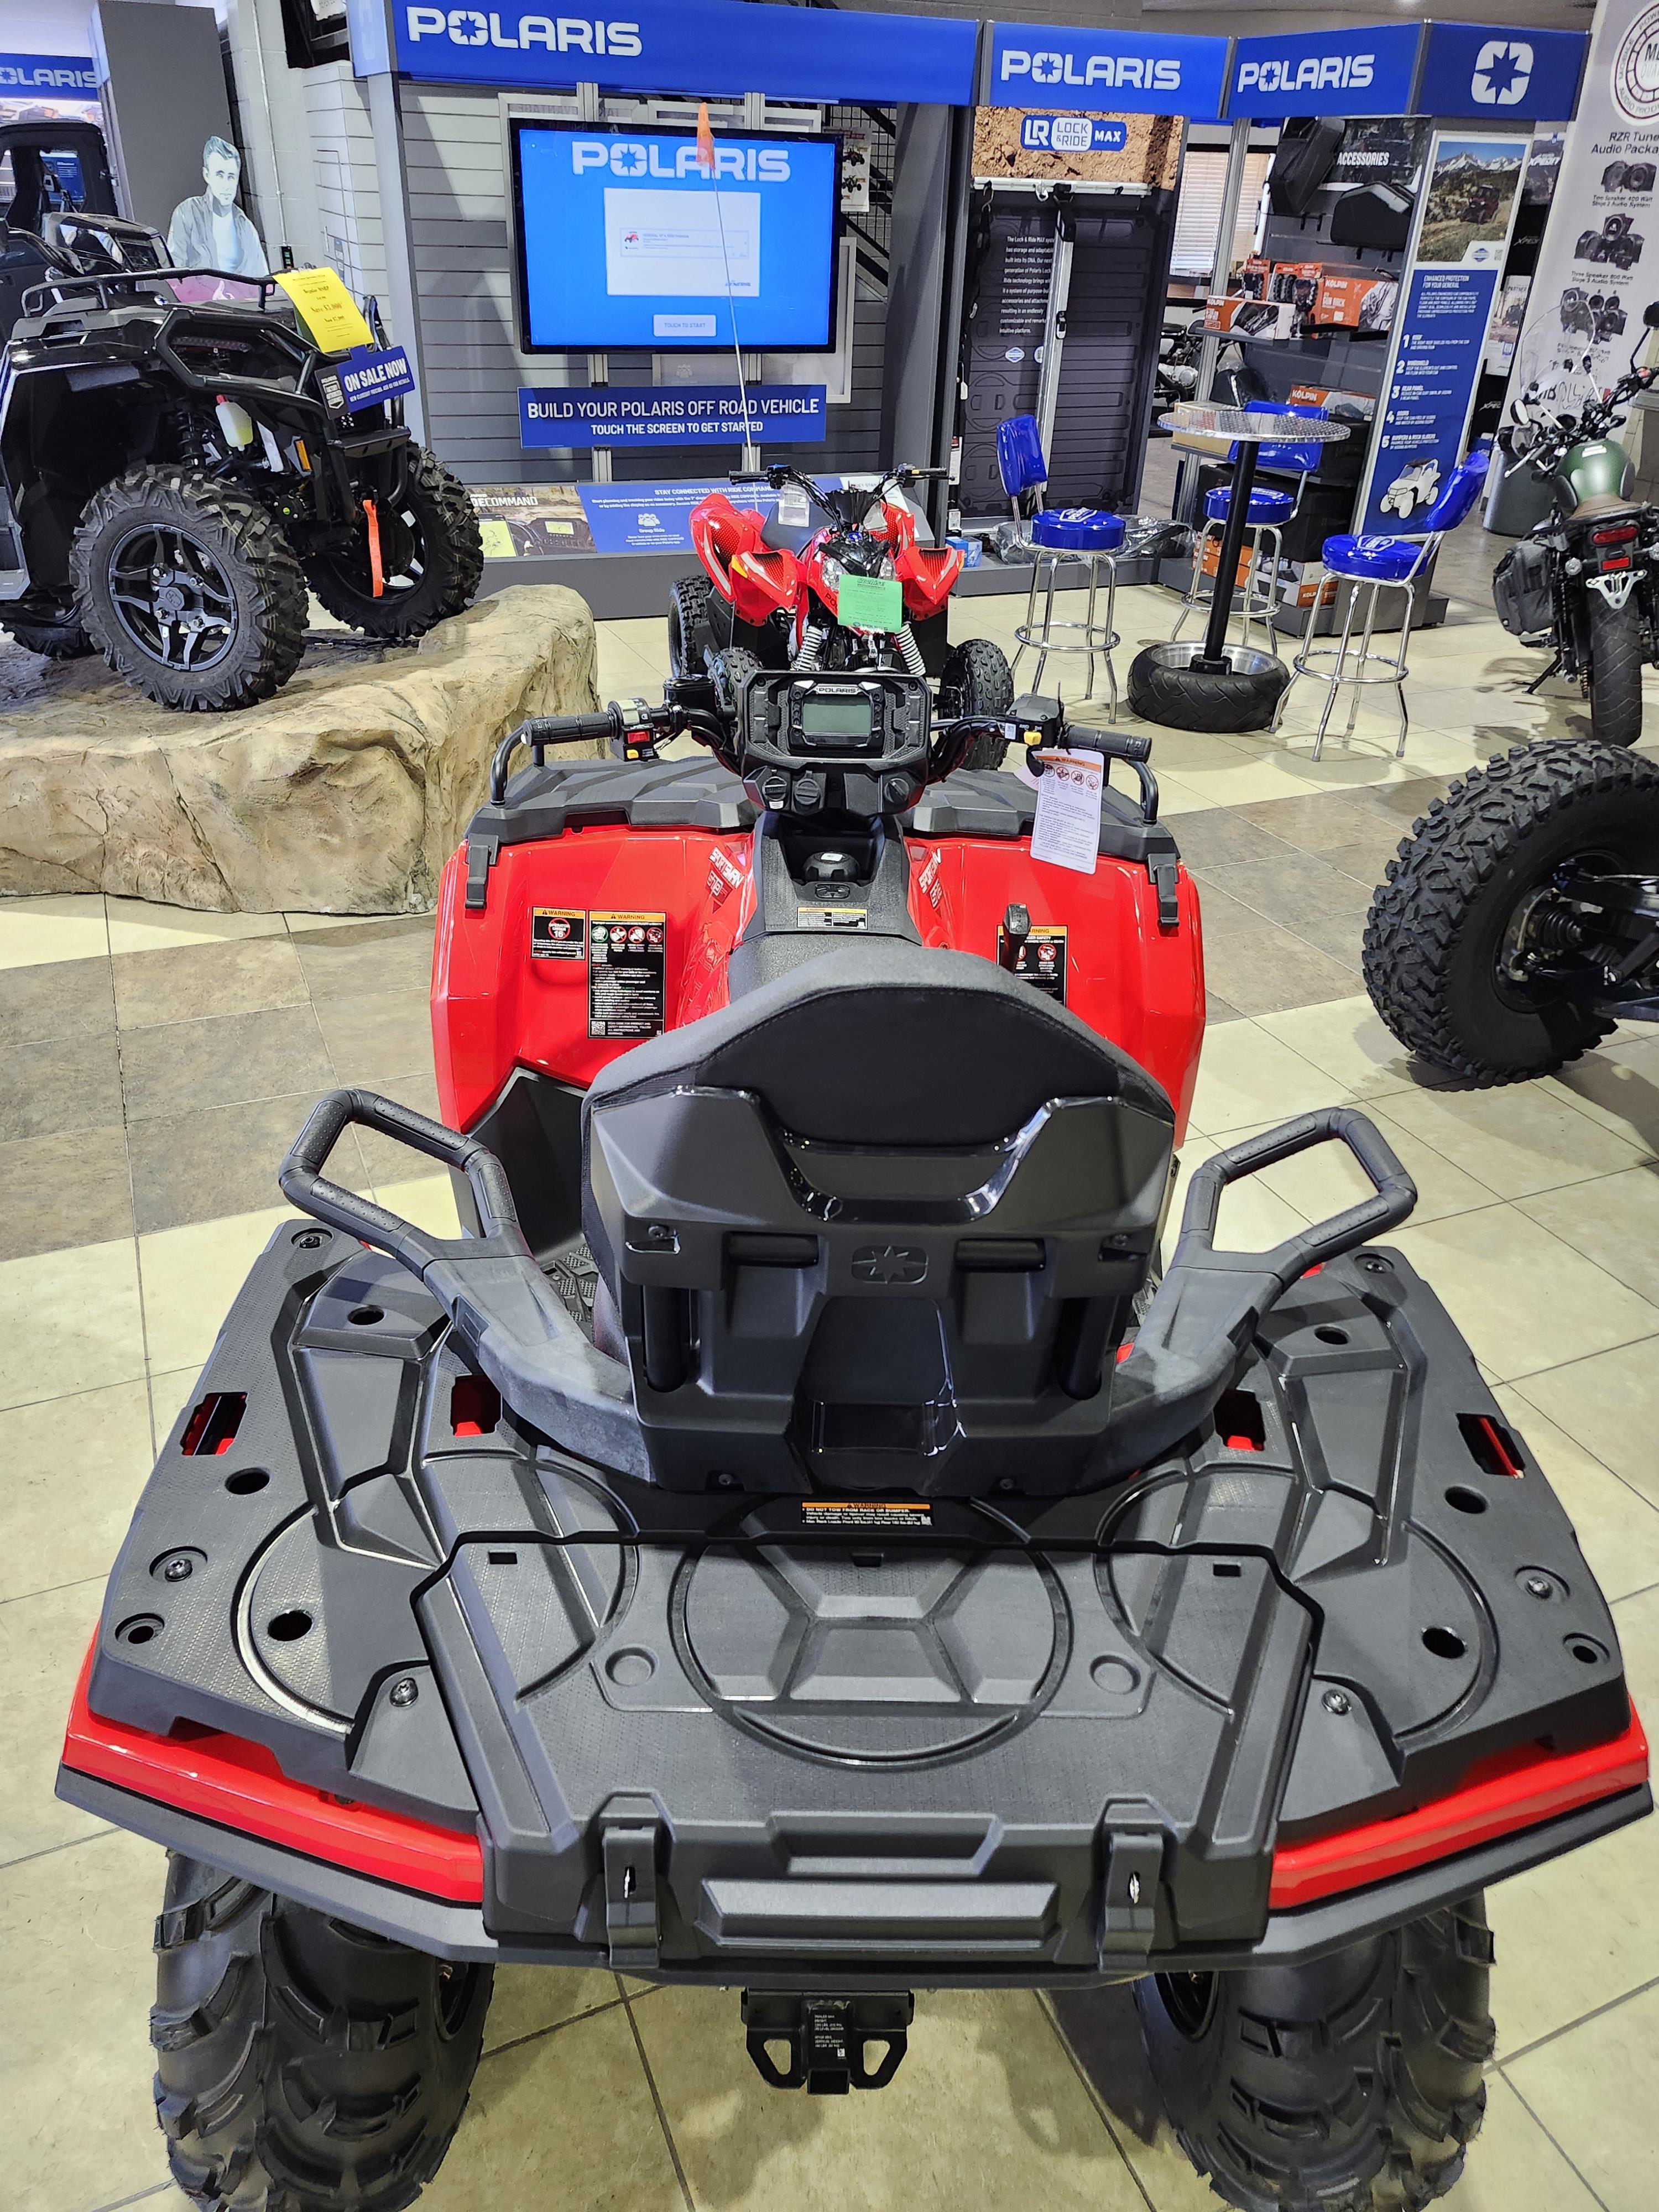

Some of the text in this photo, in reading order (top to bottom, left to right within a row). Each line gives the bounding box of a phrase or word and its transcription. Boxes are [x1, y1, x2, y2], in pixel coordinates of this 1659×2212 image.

[406, 6, 643, 57] POLARIS
[1000, 49, 1181, 91] POLARIS
[1237, 54, 1375, 93] POLARIS
[0, 67, 98, 88] OLARIS
[1057, 122, 1088, 134] LOCK
[1094, 130, 1121, 142] MAX
[1609, 132, 1659, 142] RZR Tune
[1591, 144, 1621, 154] Audio
[572, 141, 791, 182] POLARIS
[1337, 152, 1390, 166] ACCESSORIES
[1403, 334, 1410, 348] 1
[1396, 360, 1405, 374] 2
[344, 358, 407, 392] ON SALE NOW
[1292, 389, 1317, 401] KOLPIN
[1391, 385, 1400, 399] 3
[528, 398, 819, 419] BUILD YOUR POLARIS OFF ROAD VEHICLE
[1386, 411, 1395, 424] 4
[591, 421, 763, 435] TOUCH THE SCREEN TO GET STARTED
[1381, 436, 1390, 448] 5
[470, 496, 539, 507] DECOMMAND
[1061, 757, 1085, 766] WARNING
